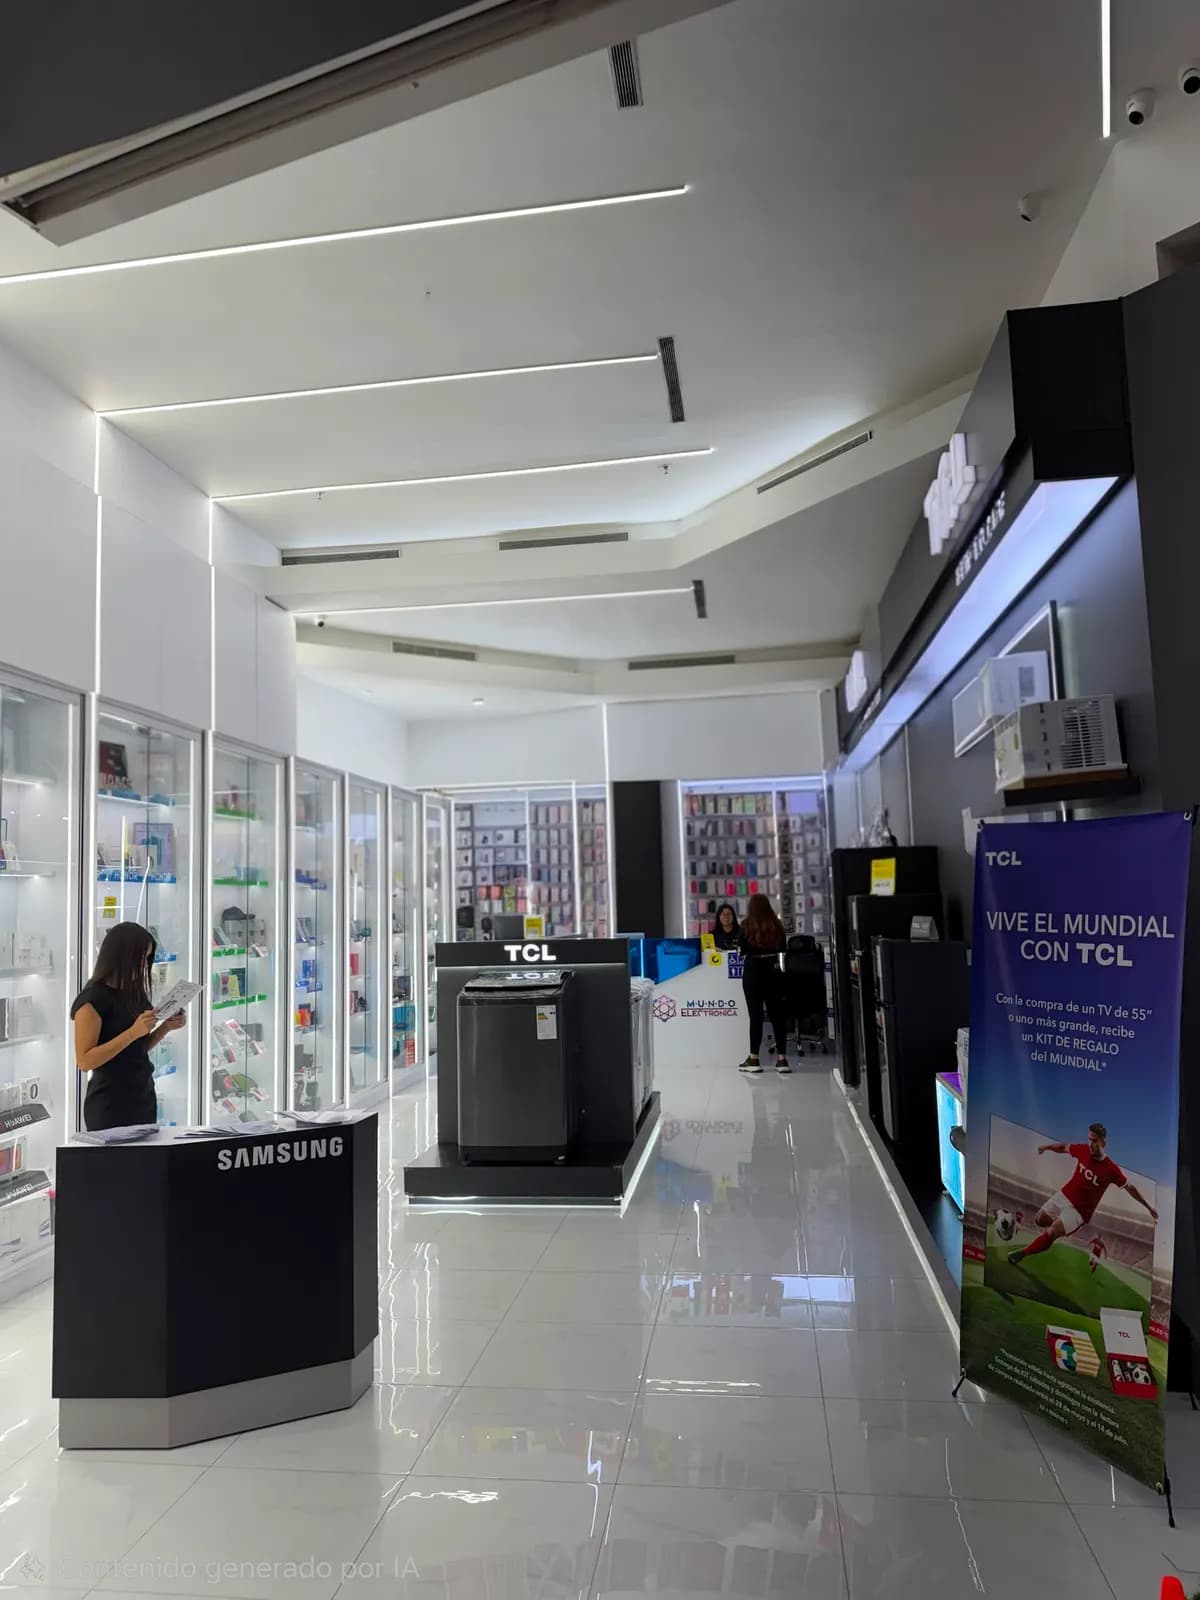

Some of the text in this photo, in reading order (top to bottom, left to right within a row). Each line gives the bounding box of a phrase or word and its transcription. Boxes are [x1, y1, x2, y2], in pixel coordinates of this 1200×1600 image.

[986, 851, 1021, 866] TCL
[987, 911, 1174, 938] VIVE EL MUNDIAL
[504, 944, 556, 962] TCL
[1021, 940, 1132, 967] CON TCL
[681, 1009, 738, 1017] ELECTRONICA
[996, 993, 1013, 1005] Con
[1015, 995, 1023, 1006] la
[1026, 999, 1063, 1014] compra
[1066, 1000, 1079, 1013] de
[1082, 1004, 1095, 1015] un
[1098, 1004, 1112, 1017] TV
[1114, 1005, 1128, 1018] de
[1016, 1015, 1034, 1025] uno
[1036, 1016, 1057, 1028] más
[1059, 1020, 1098, 1035] grande,
[1102, 1025, 1135, 1039] recibe
[1022, 1033, 1119, 1055] un KIT DE REGALO
[1031, 1050, 1047, 1062] del
[4, 1113, 32, 1128] HUAWEI
[217, 1136, 344, 1171] SAMSUNG
[1079, 1162, 1100, 1187] TCL
